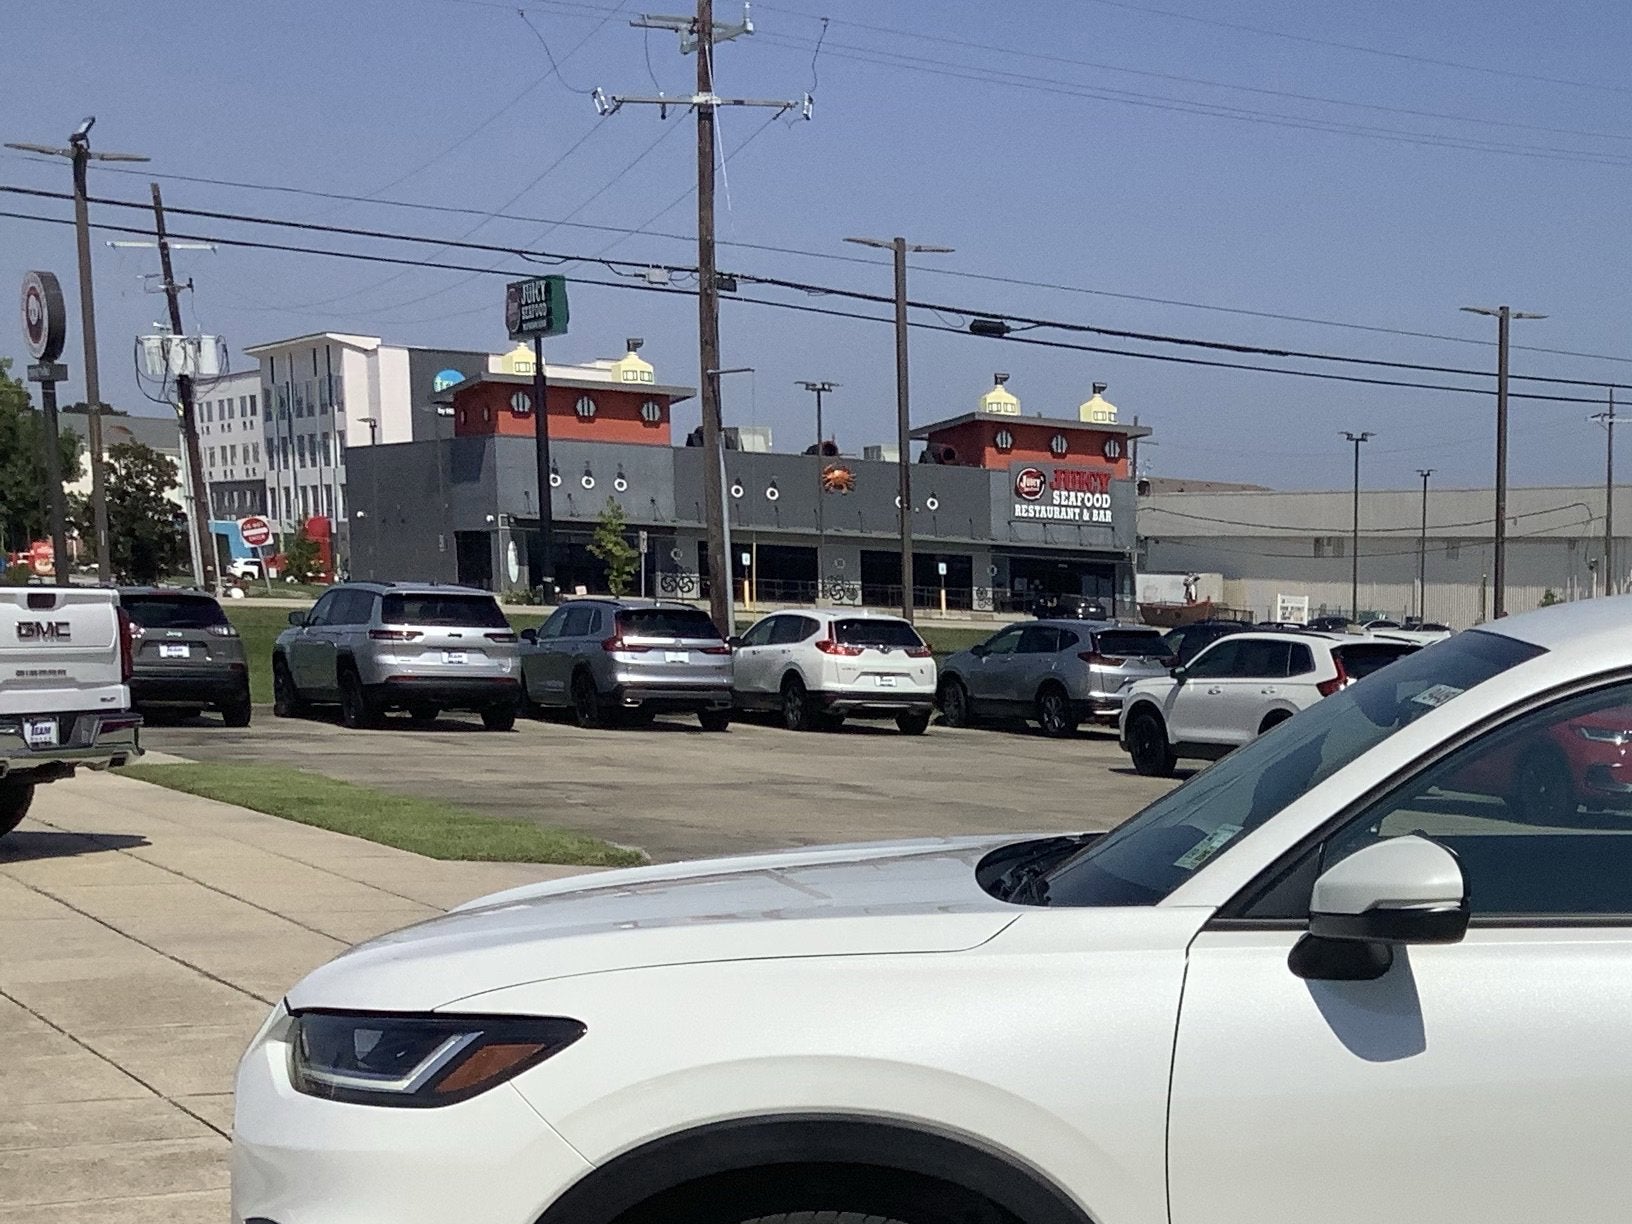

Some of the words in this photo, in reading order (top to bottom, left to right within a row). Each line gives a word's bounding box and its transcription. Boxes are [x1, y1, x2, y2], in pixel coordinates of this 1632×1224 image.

[1050, 468, 1111, 493] JUICY
[1052, 490, 1111, 508] SEAFOOD
[1014, 504, 1080, 520] RESTAURANT
[1082, 509, 1090, 521] &
[1092, 509, 1113, 522] BAR
[16, 621, 71, 638] GMC
